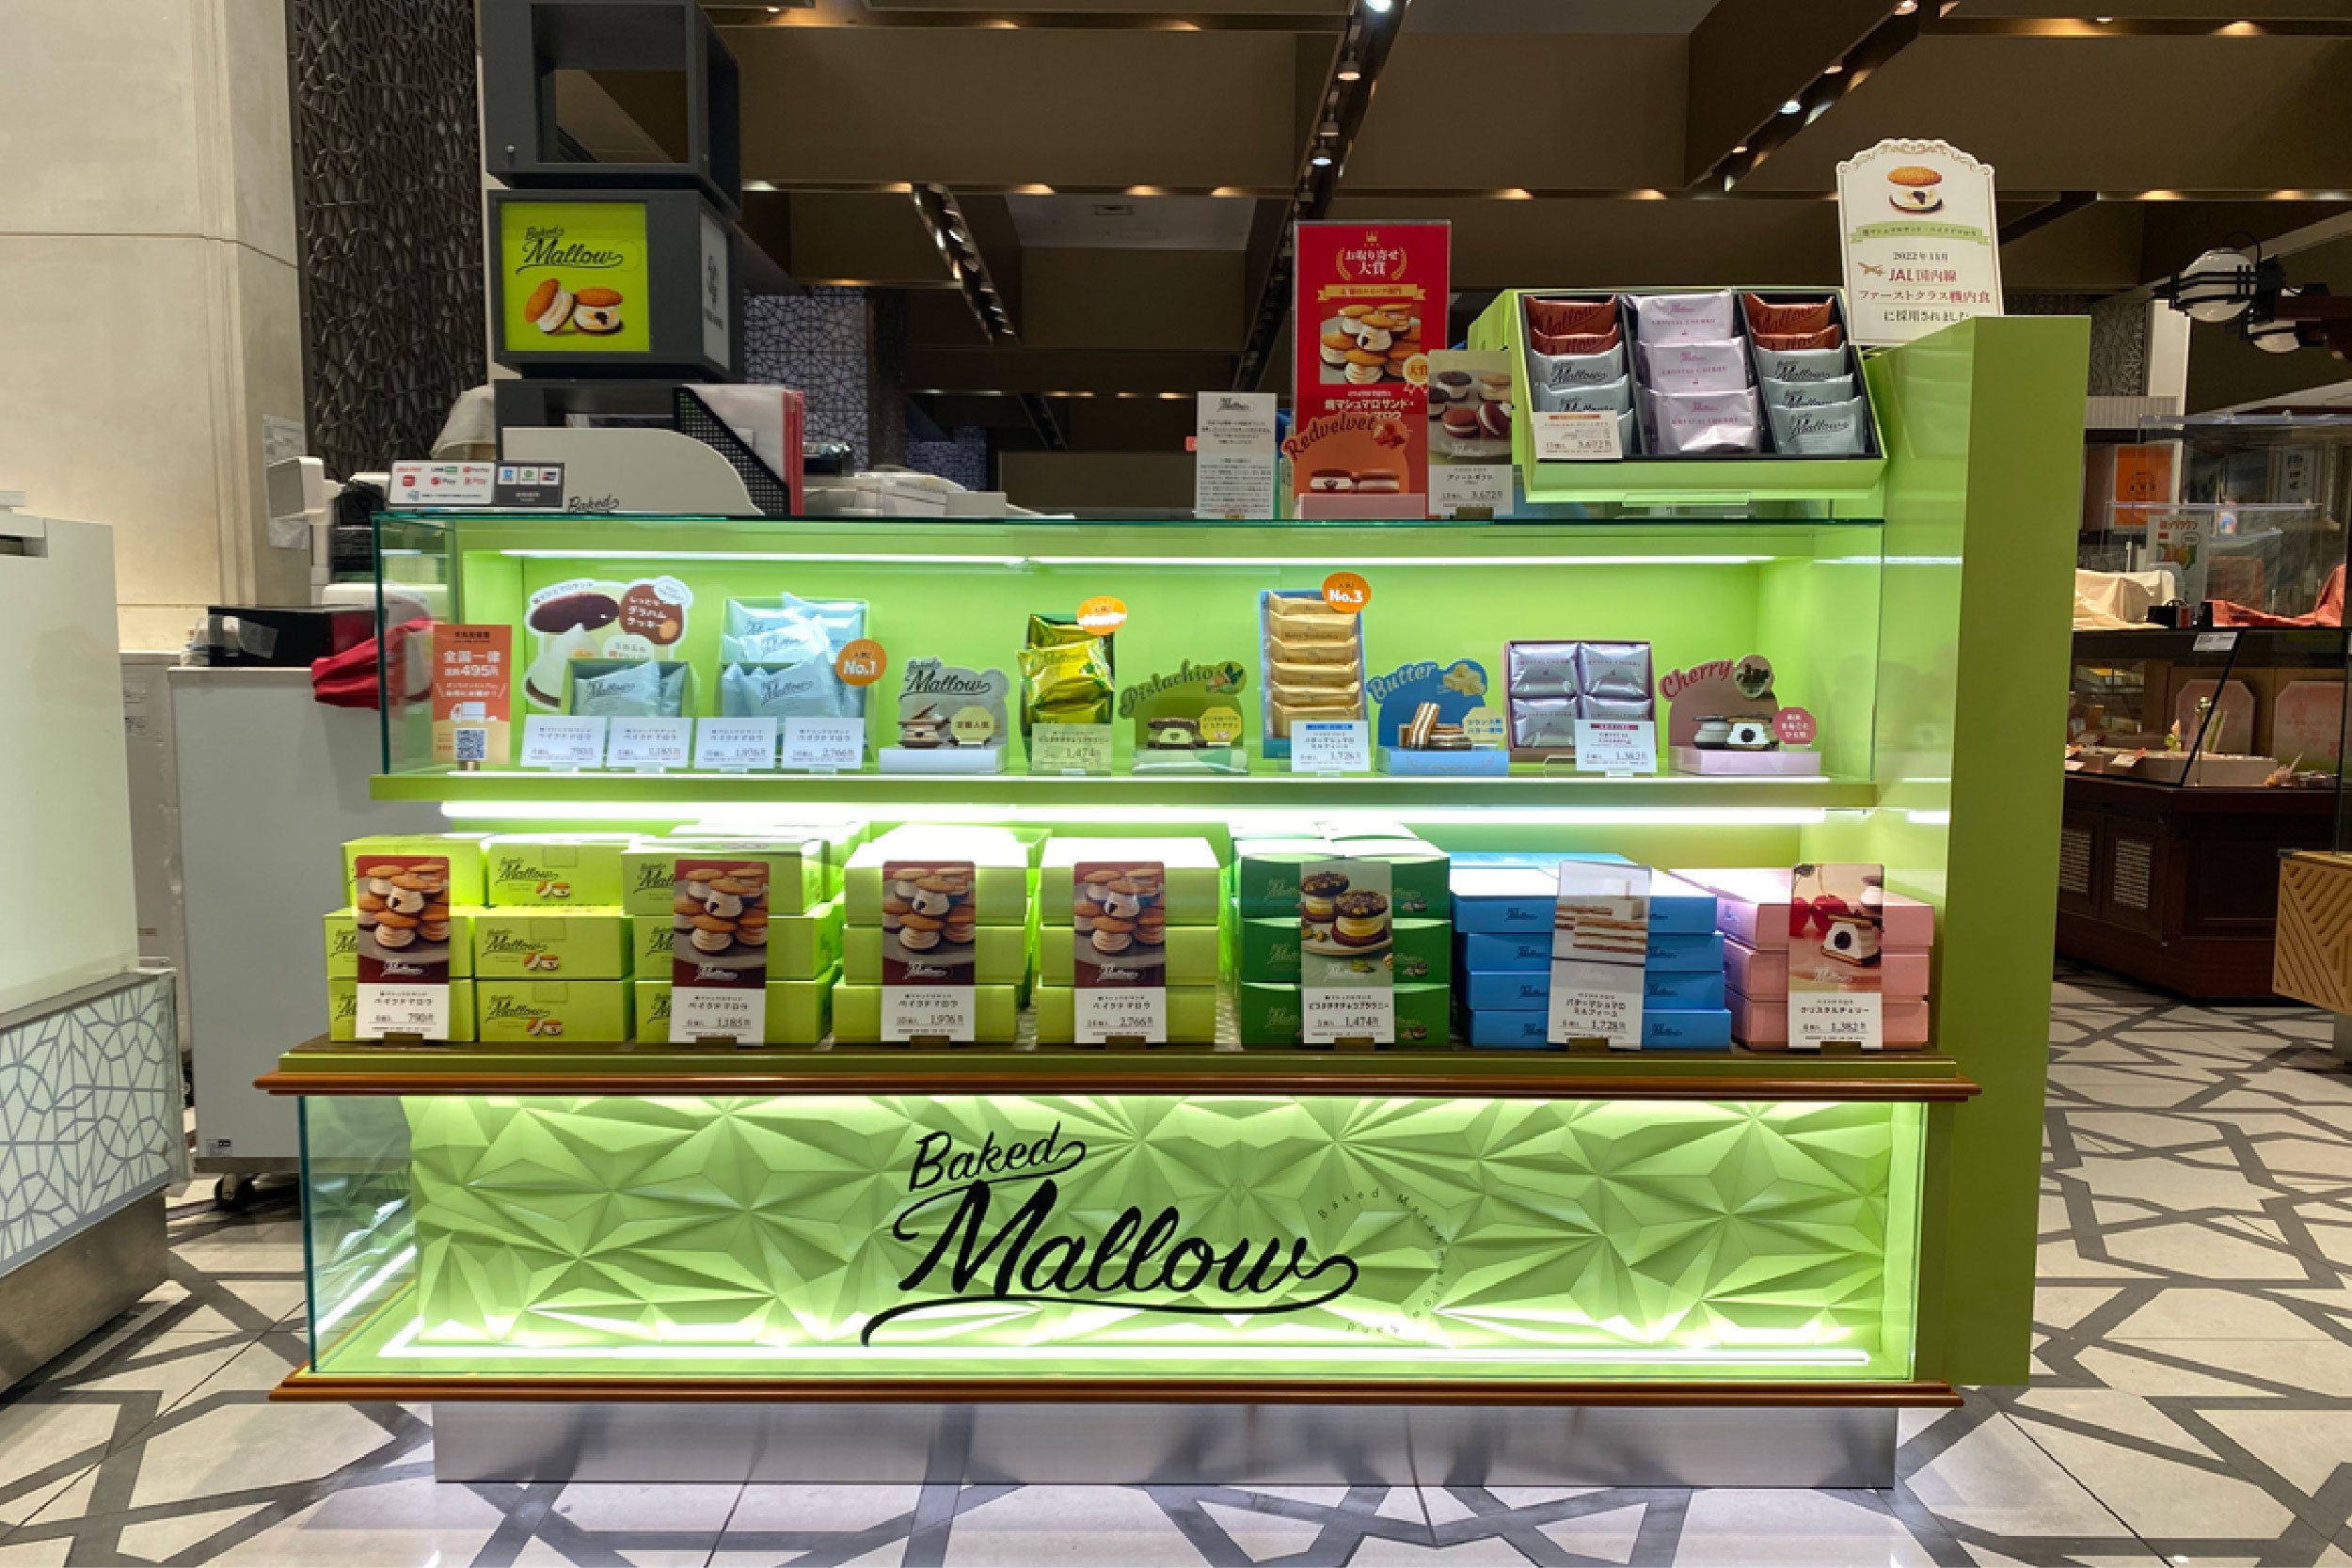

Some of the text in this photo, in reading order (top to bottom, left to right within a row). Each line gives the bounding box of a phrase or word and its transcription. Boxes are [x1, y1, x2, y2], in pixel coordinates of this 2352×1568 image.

[516, 237, 623, 274] Mallow
[1344, 249, 1399, 261] お取り寄せ
[1358, 261, 1386, 276] 大賞
[1329, 588, 1363, 603] No.3
[444, 650, 501, 663] 全国一律
[843, 660, 877, 675] No.1
[898, 670, 992, 702] Mallow
[1371, 664, 1436, 700] Butter
[1660, 660, 1734, 699] Cherry
[495, 863, 560, 885] Mallow
[482, 935, 548, 957] Mallow
[485, 1000, 550, 1022] Mallow
[909, 1121, 1085, 1191] Baked
[860, 1178, 1358, 1347] Mallow
